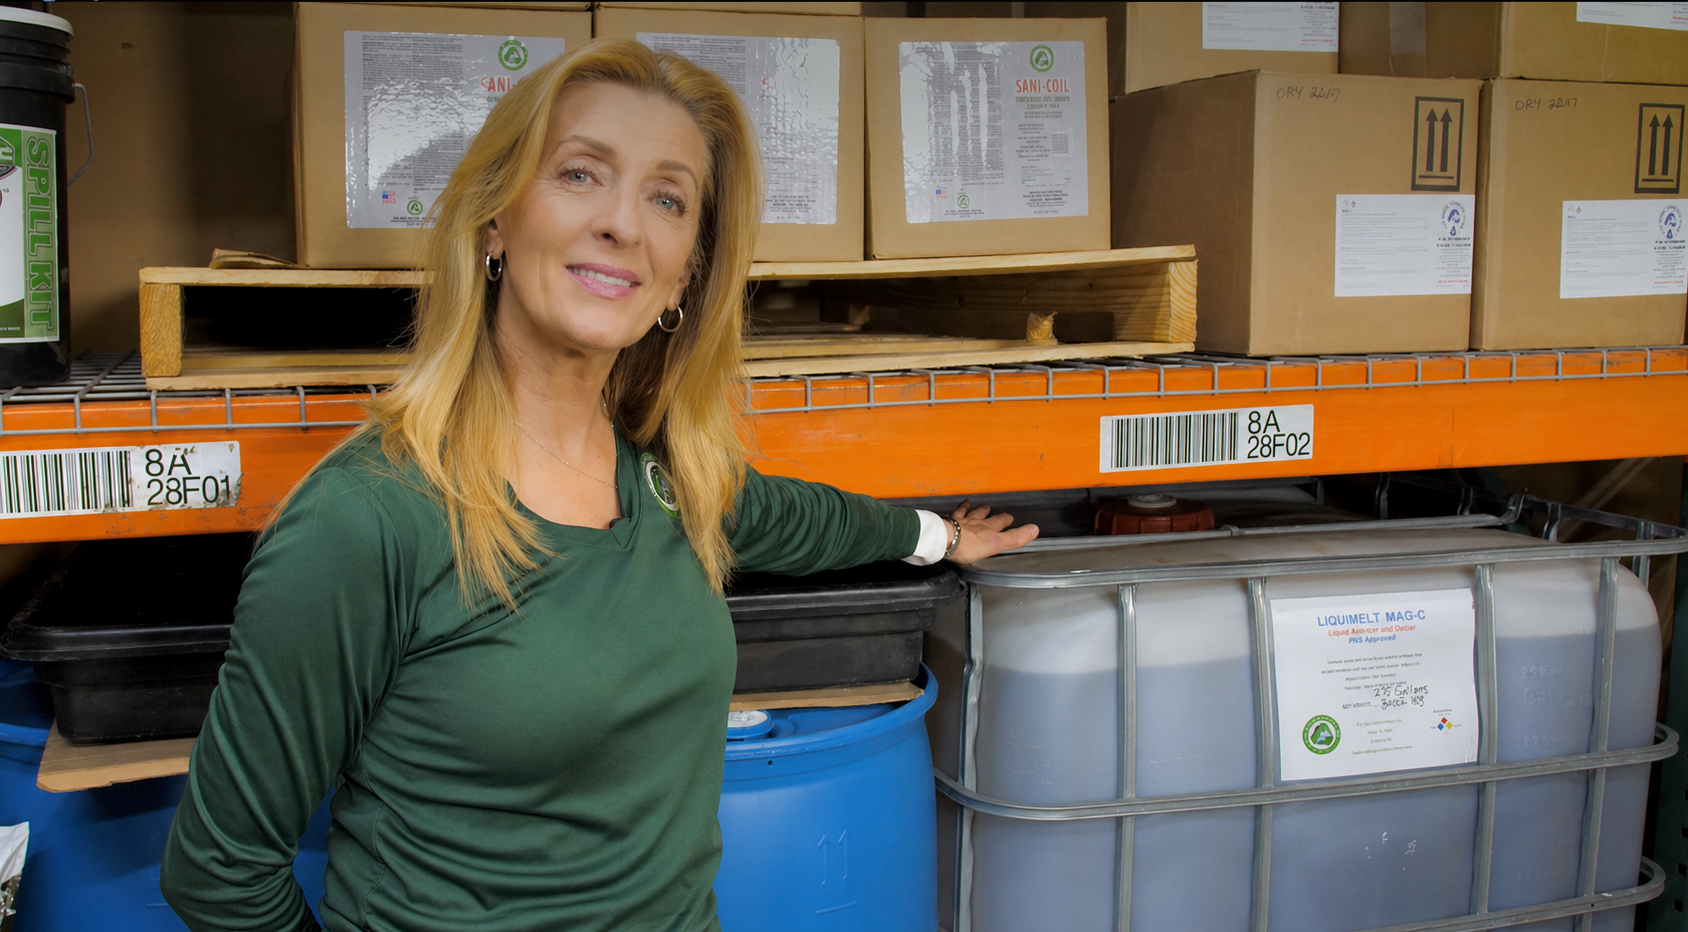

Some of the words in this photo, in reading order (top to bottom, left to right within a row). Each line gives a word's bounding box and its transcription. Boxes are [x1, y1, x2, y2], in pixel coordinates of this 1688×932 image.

[1015, 78, 1070, 93] SANI-COIL
[26, 136, 52, 256] SPILL
[29, 260, 55, 330] KIT
[1247, 410, 1281, 434] 8A
[1247, 432, 1311, 459] 28F02
[145, 448, 192, 477] 8A
[147, 474, 231, 506] 28F01
[1317, 612, 1380, 627] LIQUIMELT
[1385, 609, 1426, 622] MAG-C
[1328, 628, 1350, 637] Liquid
[1380, 625, 1394, 633] and
[1348, 636, 1363, 644] PNS
[1364, 634, 1397, 643] Approved
